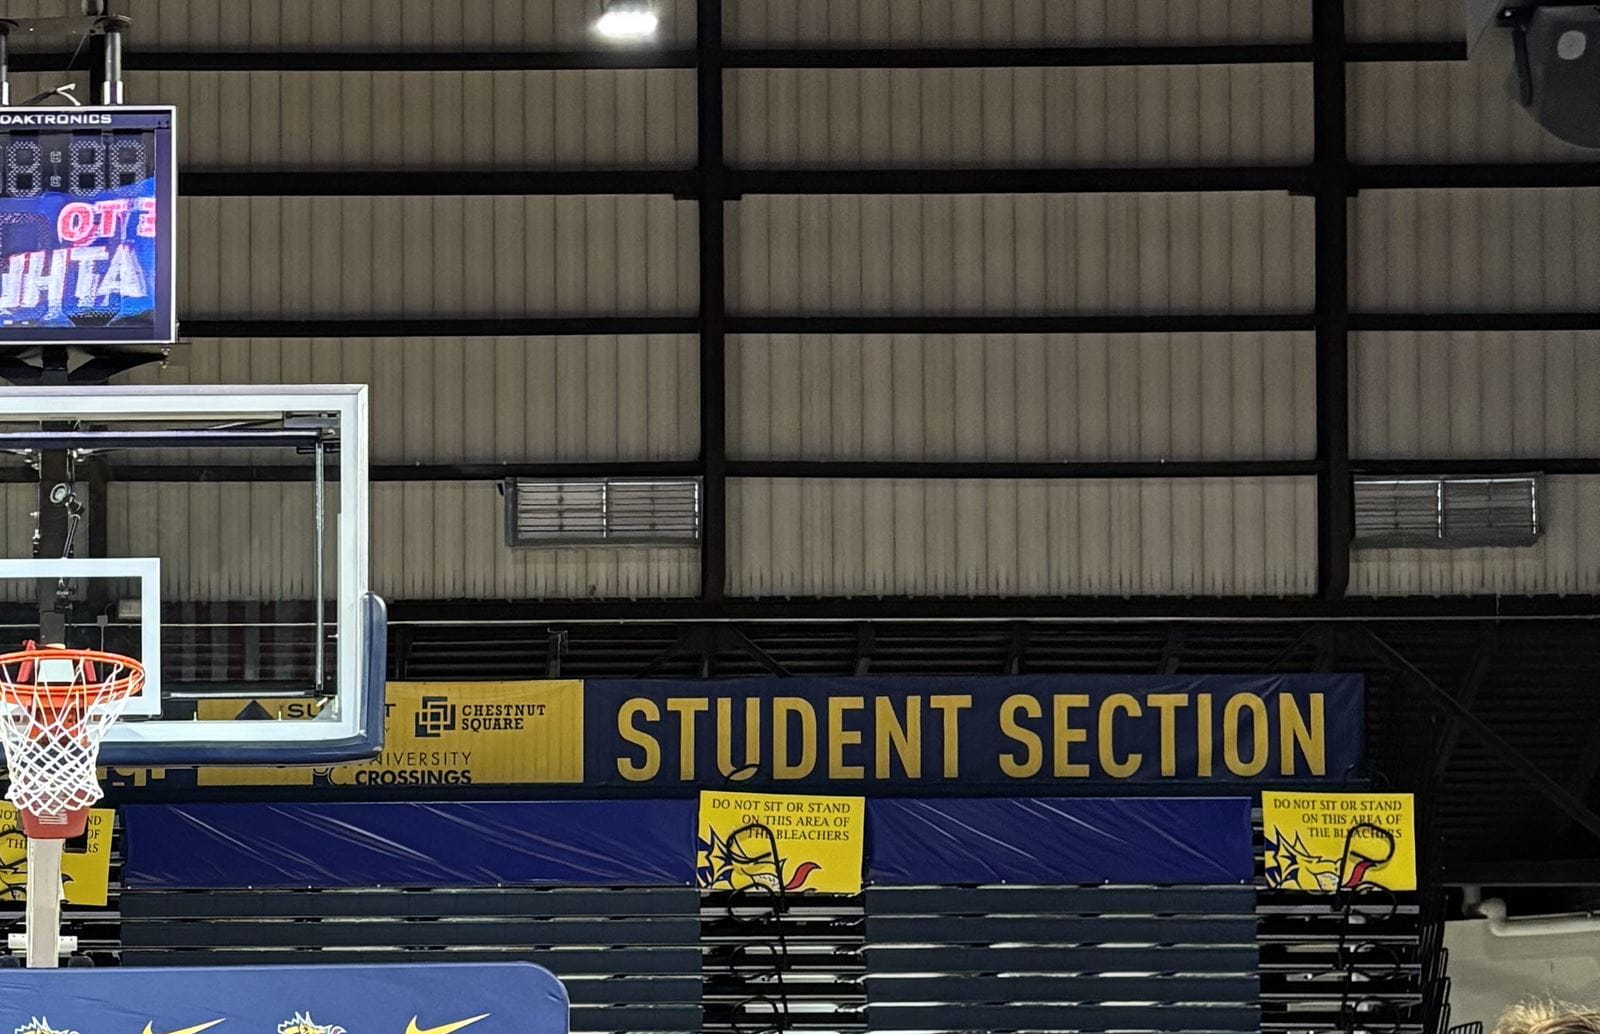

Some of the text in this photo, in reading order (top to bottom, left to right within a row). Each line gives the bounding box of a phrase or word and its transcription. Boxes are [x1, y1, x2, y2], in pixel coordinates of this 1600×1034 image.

[0, 114, 113, 125] DAKTRONICS
[461, 704, 546, 717] CHESTNUT
[461, 718, 525, 733] SQUARE
[616, 692, 1327, 783] STUDENT SECTION
[358, 751, 472, 767] NIVERSITY
[355, 769, 472, 785] CROSSINGS
[712, 798, 851, 814] DO NOT SIT OR STAND
[1273, 798, 1403, 812] DO NOT SIT OR STAND
[764, 815, 792, 826] THIS
[795, 815, 829, 827] AREA
[833, 816, 850, 828] OF
[1302, 813, 1318, 824] ON
[1321, 813, 1347, 825] THIS
[1385, 814, 1403, 825] OF
[776, 829, 849, 841] BLEACHERS
[1306, 827, 1330, 838] THE
